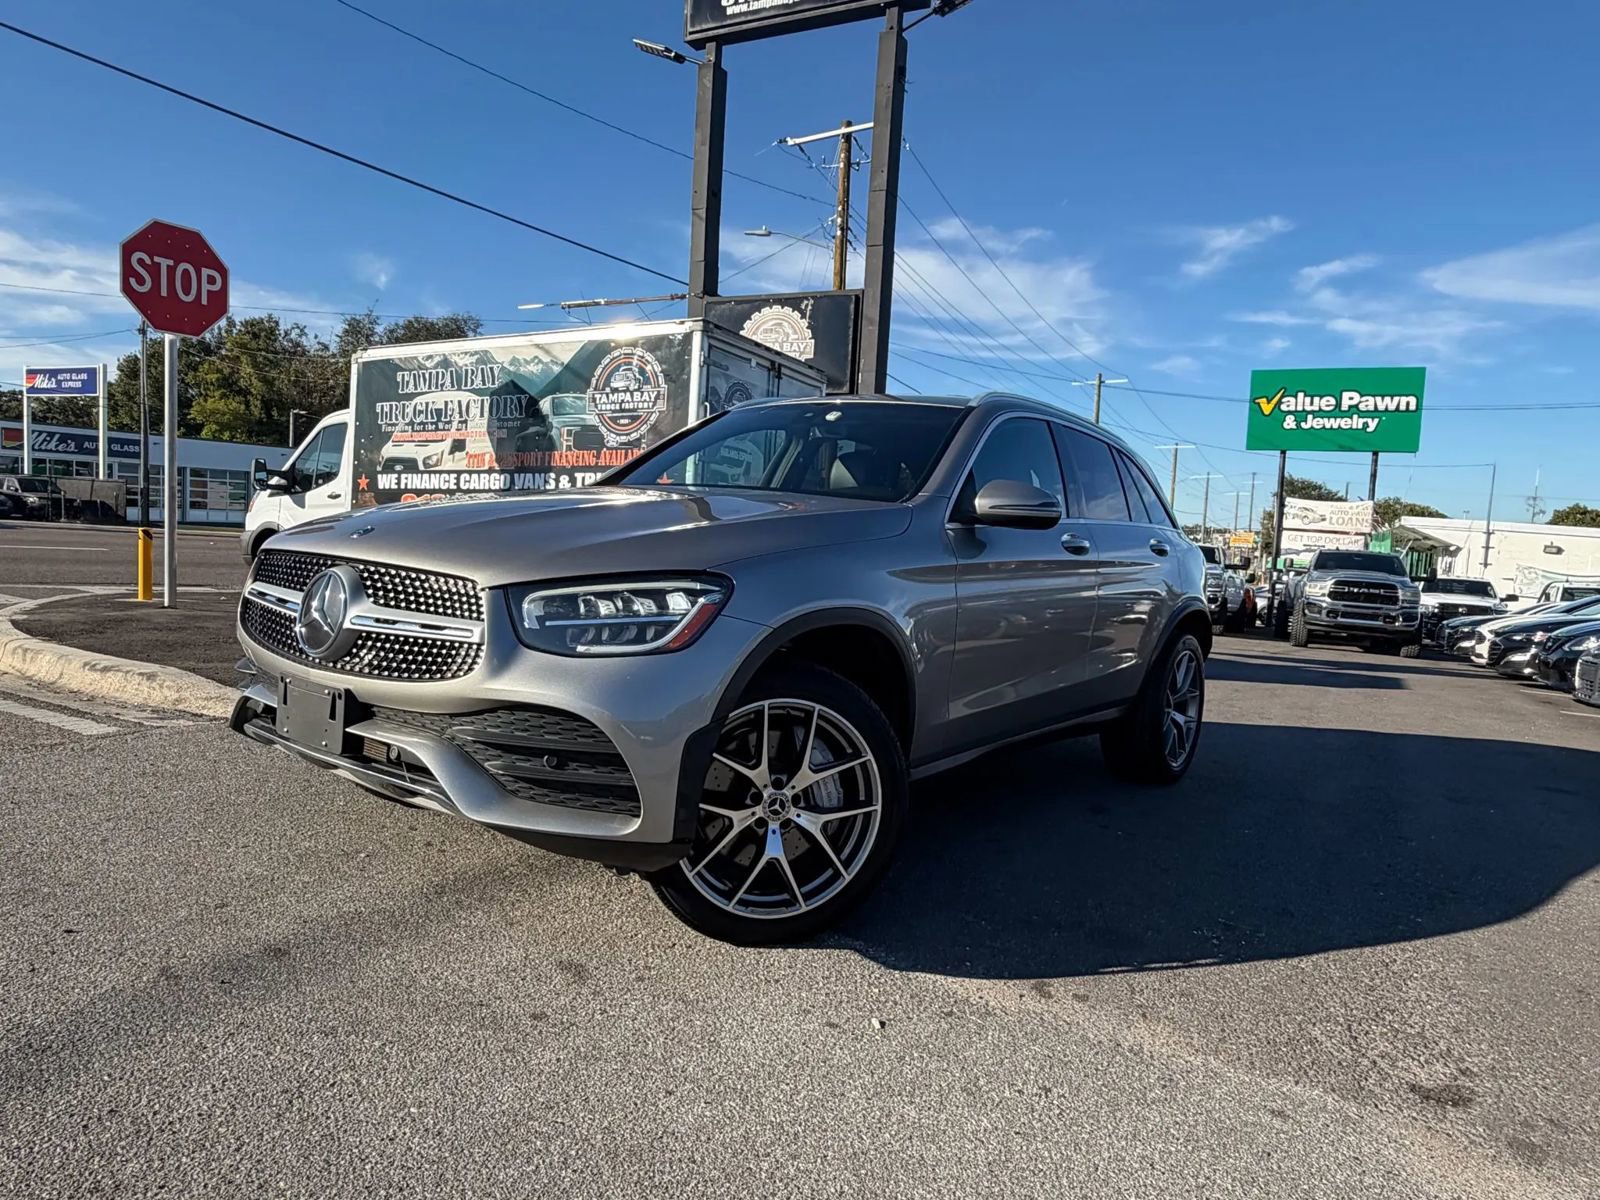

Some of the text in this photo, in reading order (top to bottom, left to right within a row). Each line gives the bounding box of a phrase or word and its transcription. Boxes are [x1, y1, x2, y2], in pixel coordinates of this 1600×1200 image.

[128, 251, 222, 305] STOP
[783, 342, 806, 351] BAY
[34, 373, 57, 388] Mike's
[71, 372, 88, 380] GLASS
[397, 365, 502, 393] TAMPA BAY
[594, 391, 657, 404] TAMPA BAY
[621, 402, 653, 410] FACTORY
[1340, 391, 1417, 411] Pawn
[377, 395, 529, 424] TRUCK FACTORY
[414, 423, 424, 431] for
[425, 422, 436, 430] the
[1283, 414, 1379, 432] & Jewelry
[32, 431, 78, 452] Mike's
[111, 444, 140, 452] GLASS
[545, 450, 597, 467] FINANCING
[377, 474, 398, 490] WE
[401, 474, 457, 489] FINANCE
[460, 473, 510, 489] CARGO
[514, 472, 556, 489] VANS
[559, 474, 571, 488] &
[1329, 516, 1371, 527] LOANS
[1288, 534, 1304, 543] GET
[1306, 535, 1323, 543] TOP
